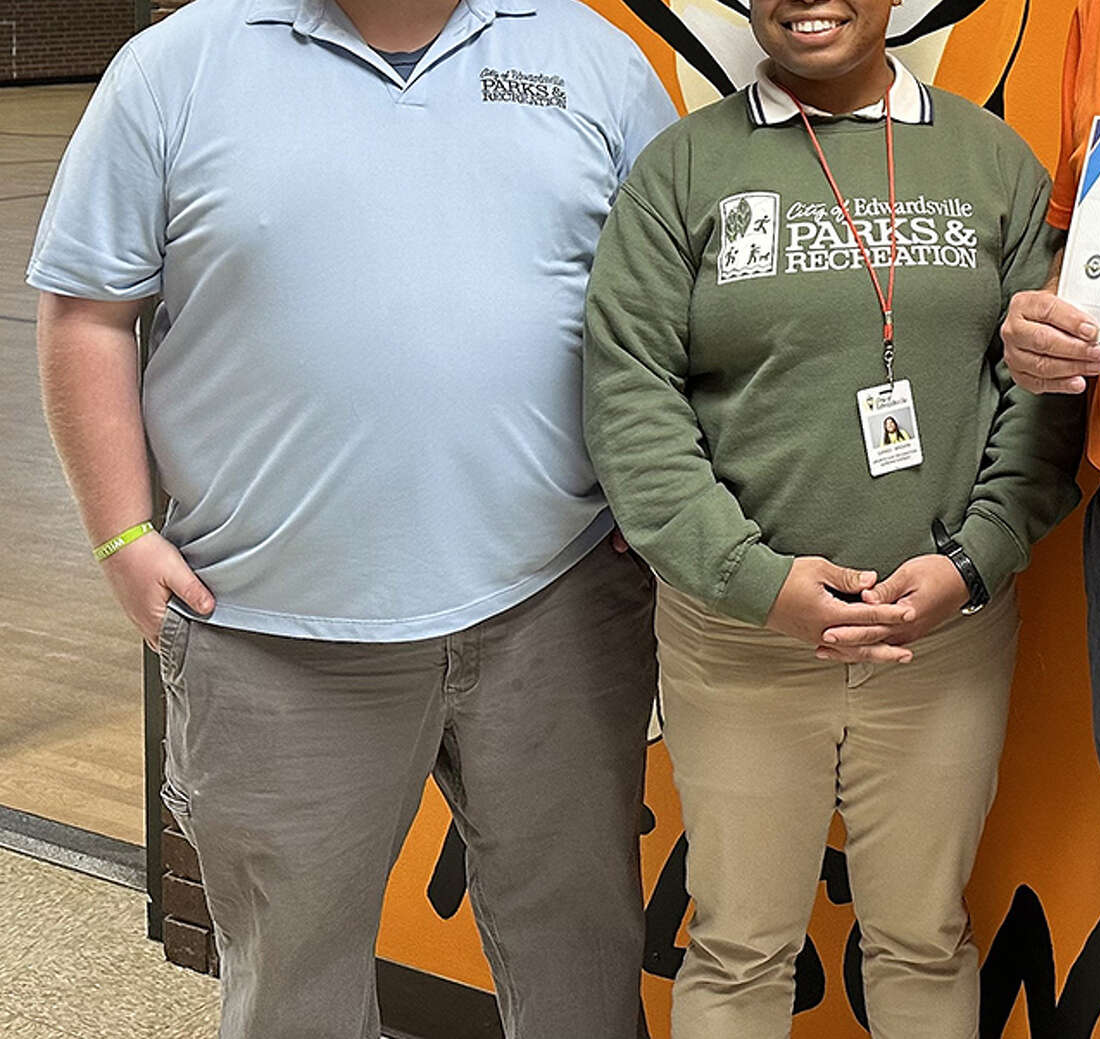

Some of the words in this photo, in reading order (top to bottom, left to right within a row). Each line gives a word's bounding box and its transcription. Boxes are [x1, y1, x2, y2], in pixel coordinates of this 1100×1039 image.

[480, 78, 549, 98] PARKS
[551, 86, 567, 100] &
[482, 90, 567, 109] RECREATION
[786, 201, 827, 225] City
[853, 195, 973, 217] Edwardsville
[785, 217, 939, 251] PARKS
[944, 219, 977, 247] &
[784, 245, 977, 274] RECREATION
